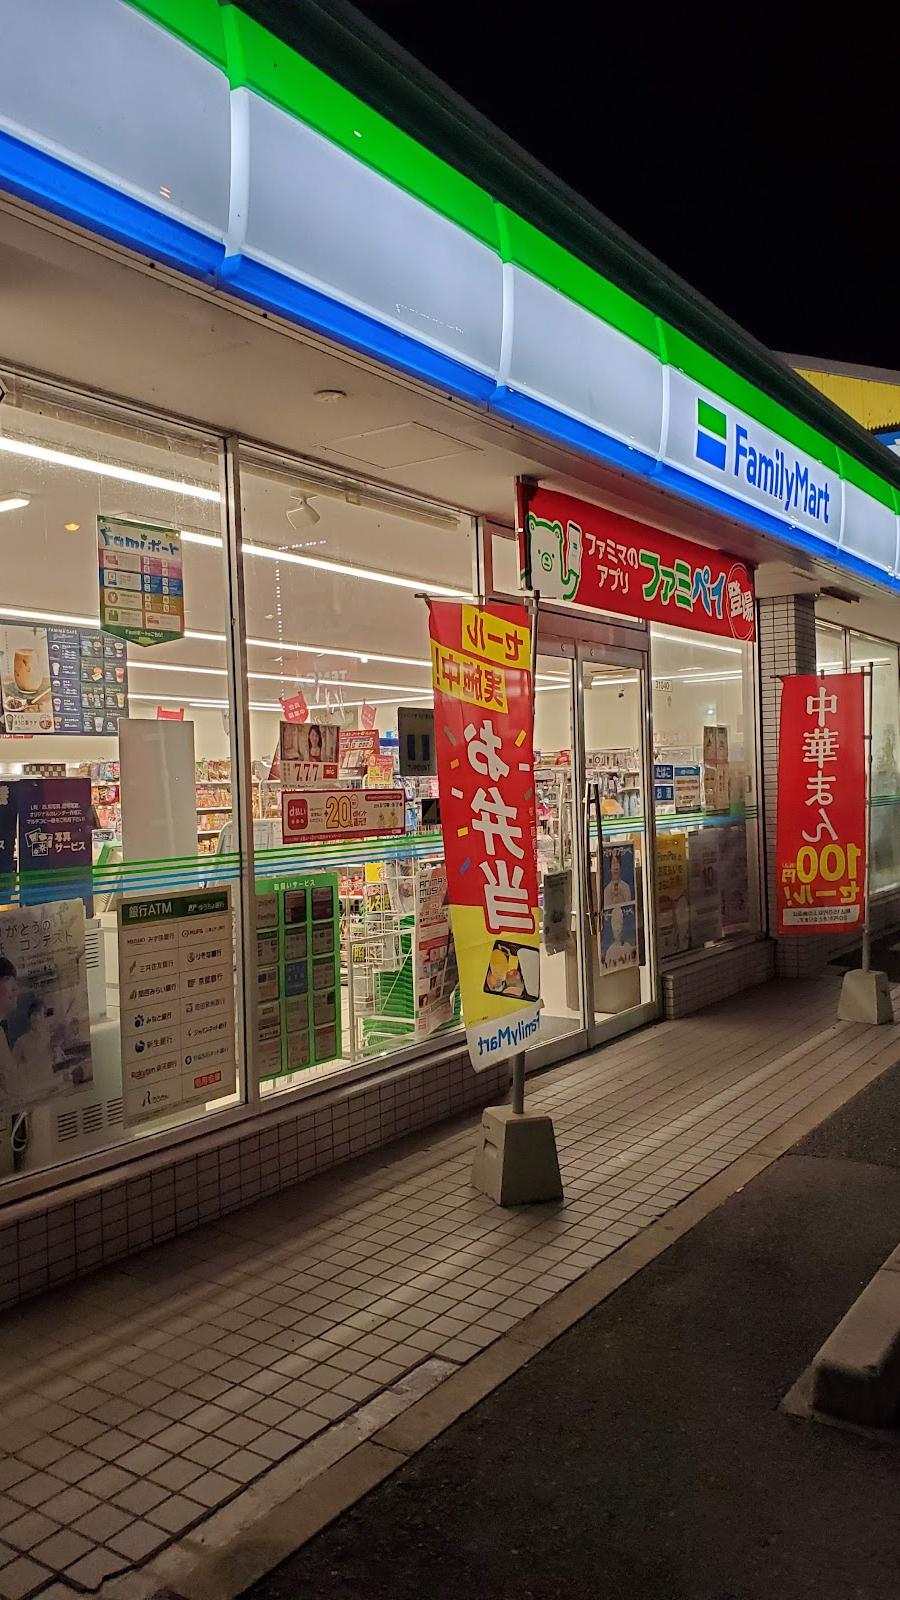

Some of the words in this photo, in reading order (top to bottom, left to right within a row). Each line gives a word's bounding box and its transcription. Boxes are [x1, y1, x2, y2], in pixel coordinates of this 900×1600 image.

[734, 423, 830, 524] FamilyMart
[584, 532, 640, 570] ファミマの
[596, 565, 630, 594] アプリ
[639, 549, 726, 620] ファミペイ
[727, 580, 754, 623] 登場
[54, 841, 86, 852] サービス
[128, 901, 172, 918] 銀行ATM
[20, 928, 73, 951] コンテスト
[195, 949, 222, 961] りそな銀行
